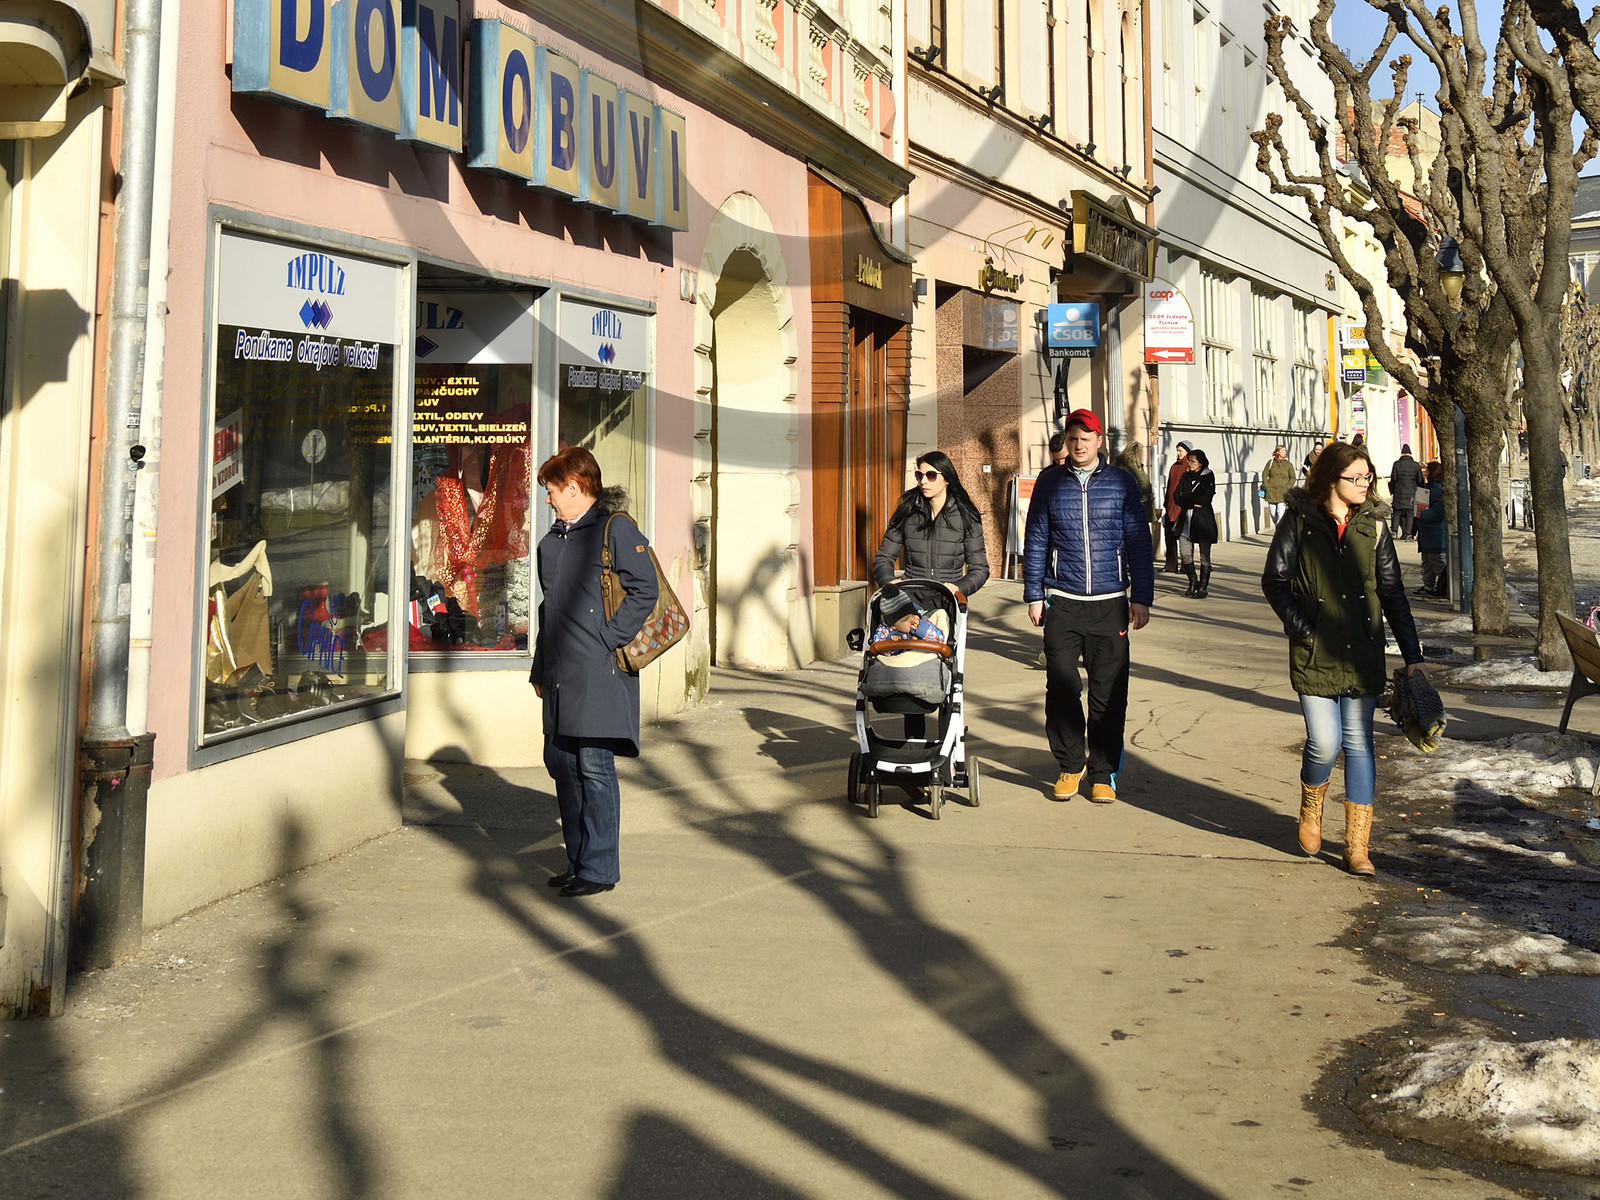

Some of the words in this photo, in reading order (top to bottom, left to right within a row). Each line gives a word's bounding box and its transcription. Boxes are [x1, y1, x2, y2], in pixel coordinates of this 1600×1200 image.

[502, 48, 680, 212] OBUVI
[287, 253, 346, 296] IMPULZ
[1149, 290, 1174, 302] coop
[415, 301, 464, 330] ULZ
[591, 310, 623, 340] IMPULZ
[1052, 327, 1095, 341] ČSOB
[234, 328, 294, 362] Ponúkame
[297, 334, 342, 371] okrajové
[1049, 348, 1091, 358] Bankomat
[415, 376, 480, 386] BUV,TEXTIL
[416, 398, 439, 407] BUV
[412, 412, 444, 421] EXTIL,
[445, 411, 484, 421] ODEVY
